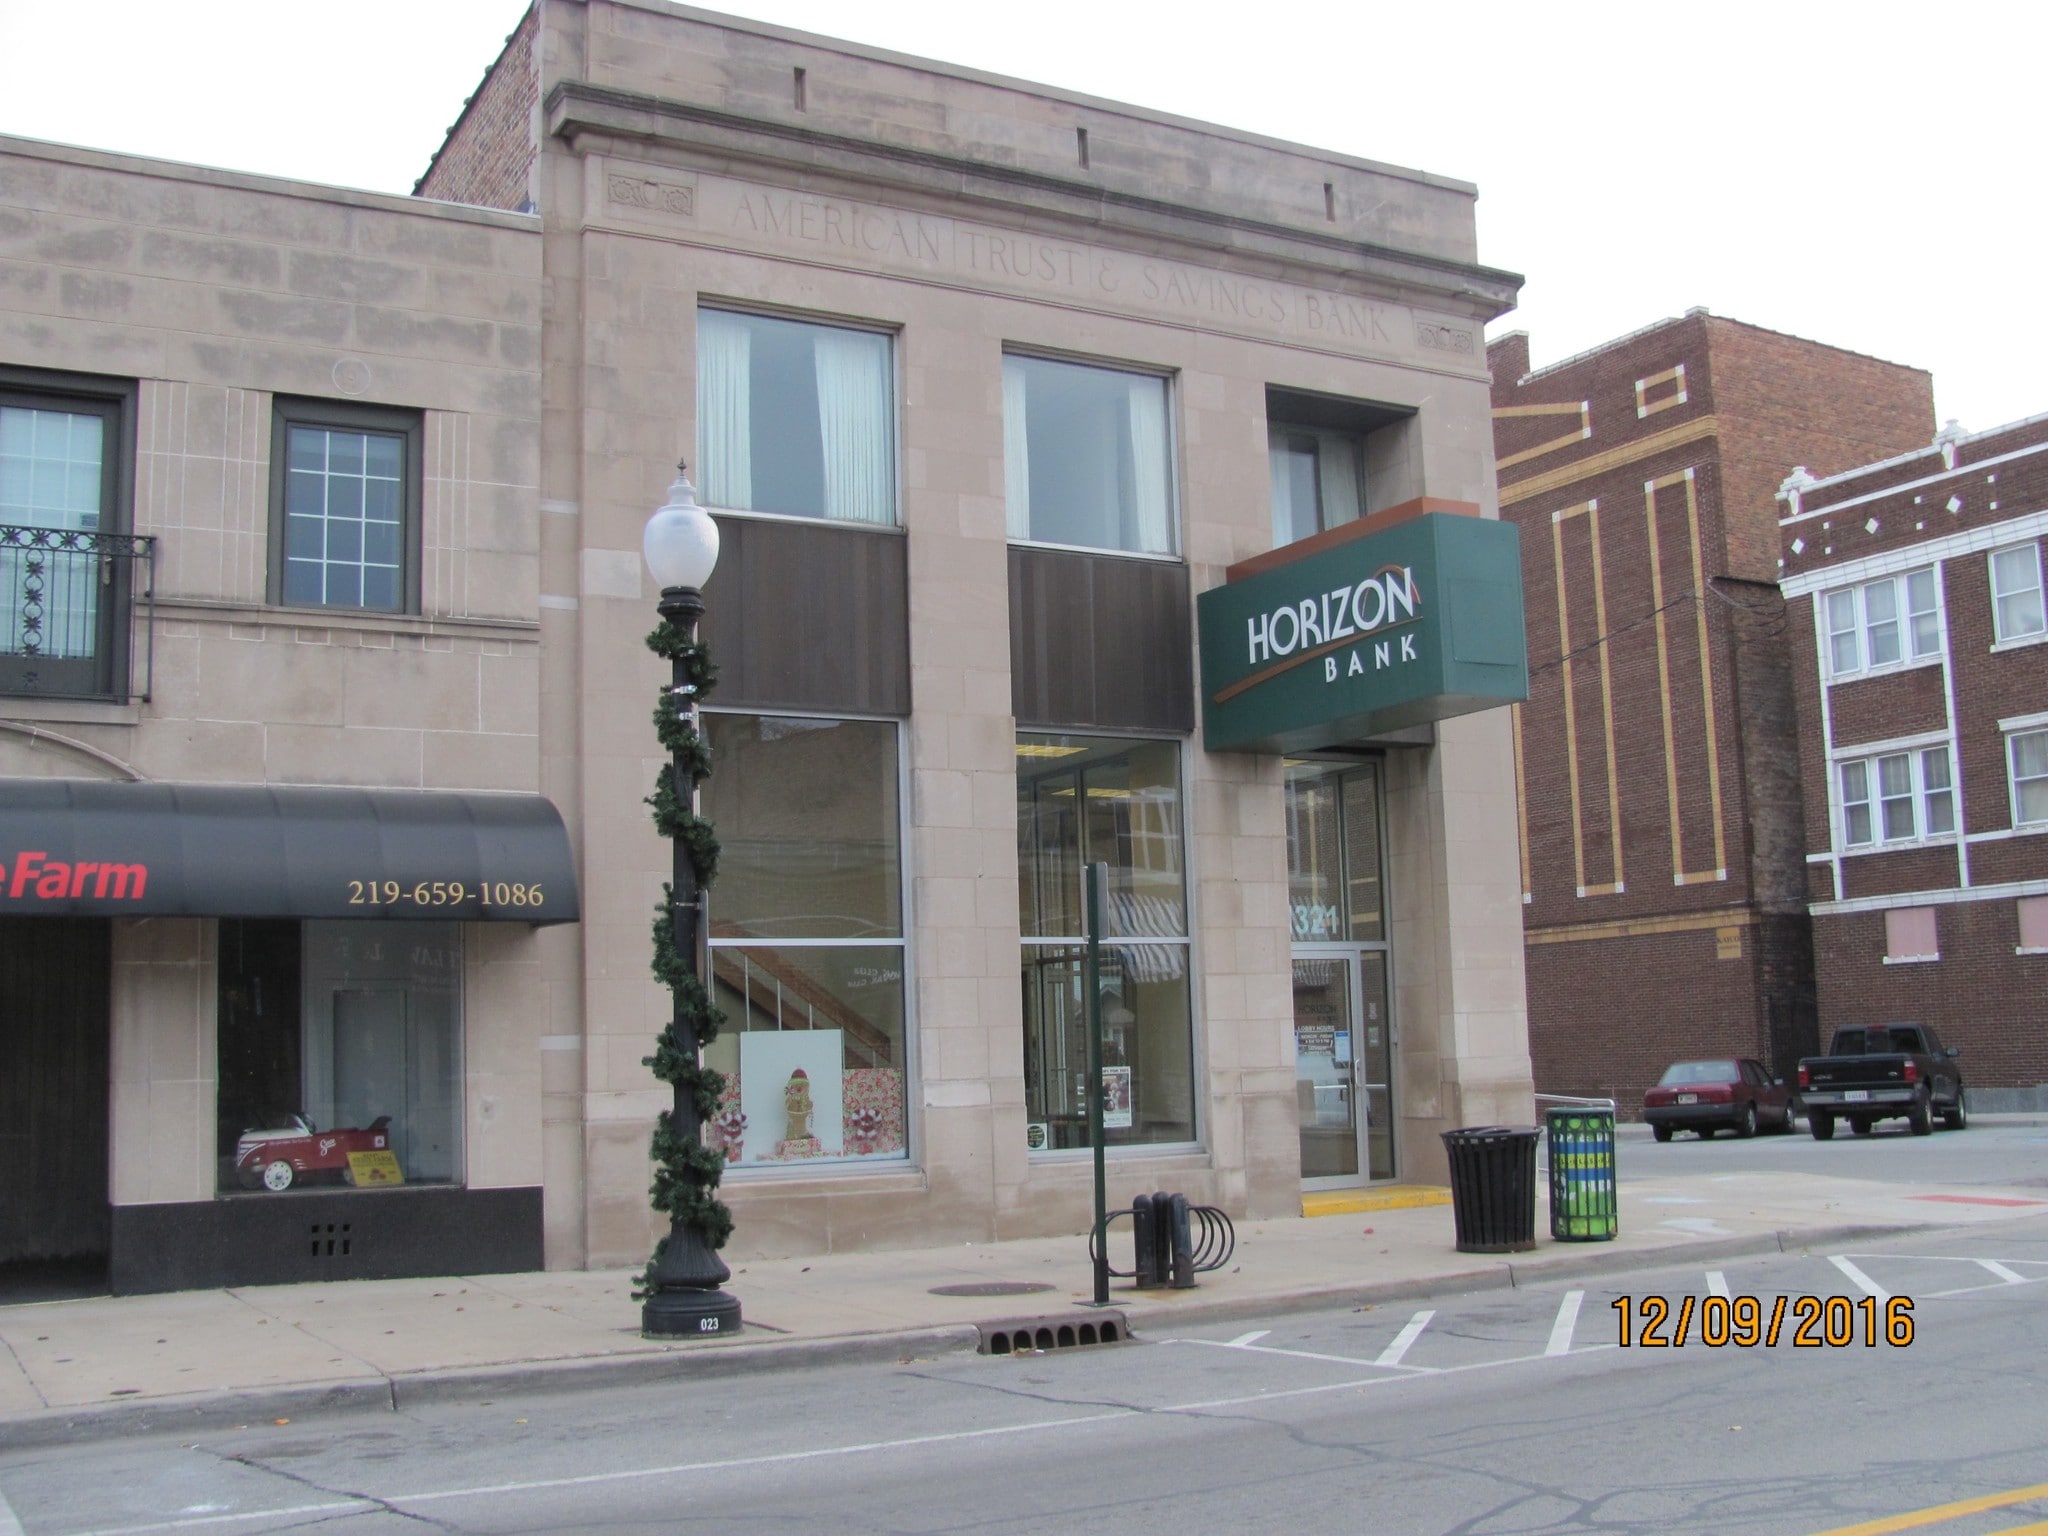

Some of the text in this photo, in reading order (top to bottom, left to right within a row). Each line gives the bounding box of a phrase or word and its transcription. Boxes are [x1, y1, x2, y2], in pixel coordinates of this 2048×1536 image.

[732, 194, 1391, 344] AMERICAN TRUST & SAVINGS BANK
[1247, 566, 1414, 664] HORIZON
[1324, 633, 1417, 683] BANK
[348, 880, 544, 906] 219-659-1086
[700, 1317, 719, 1331] 023
